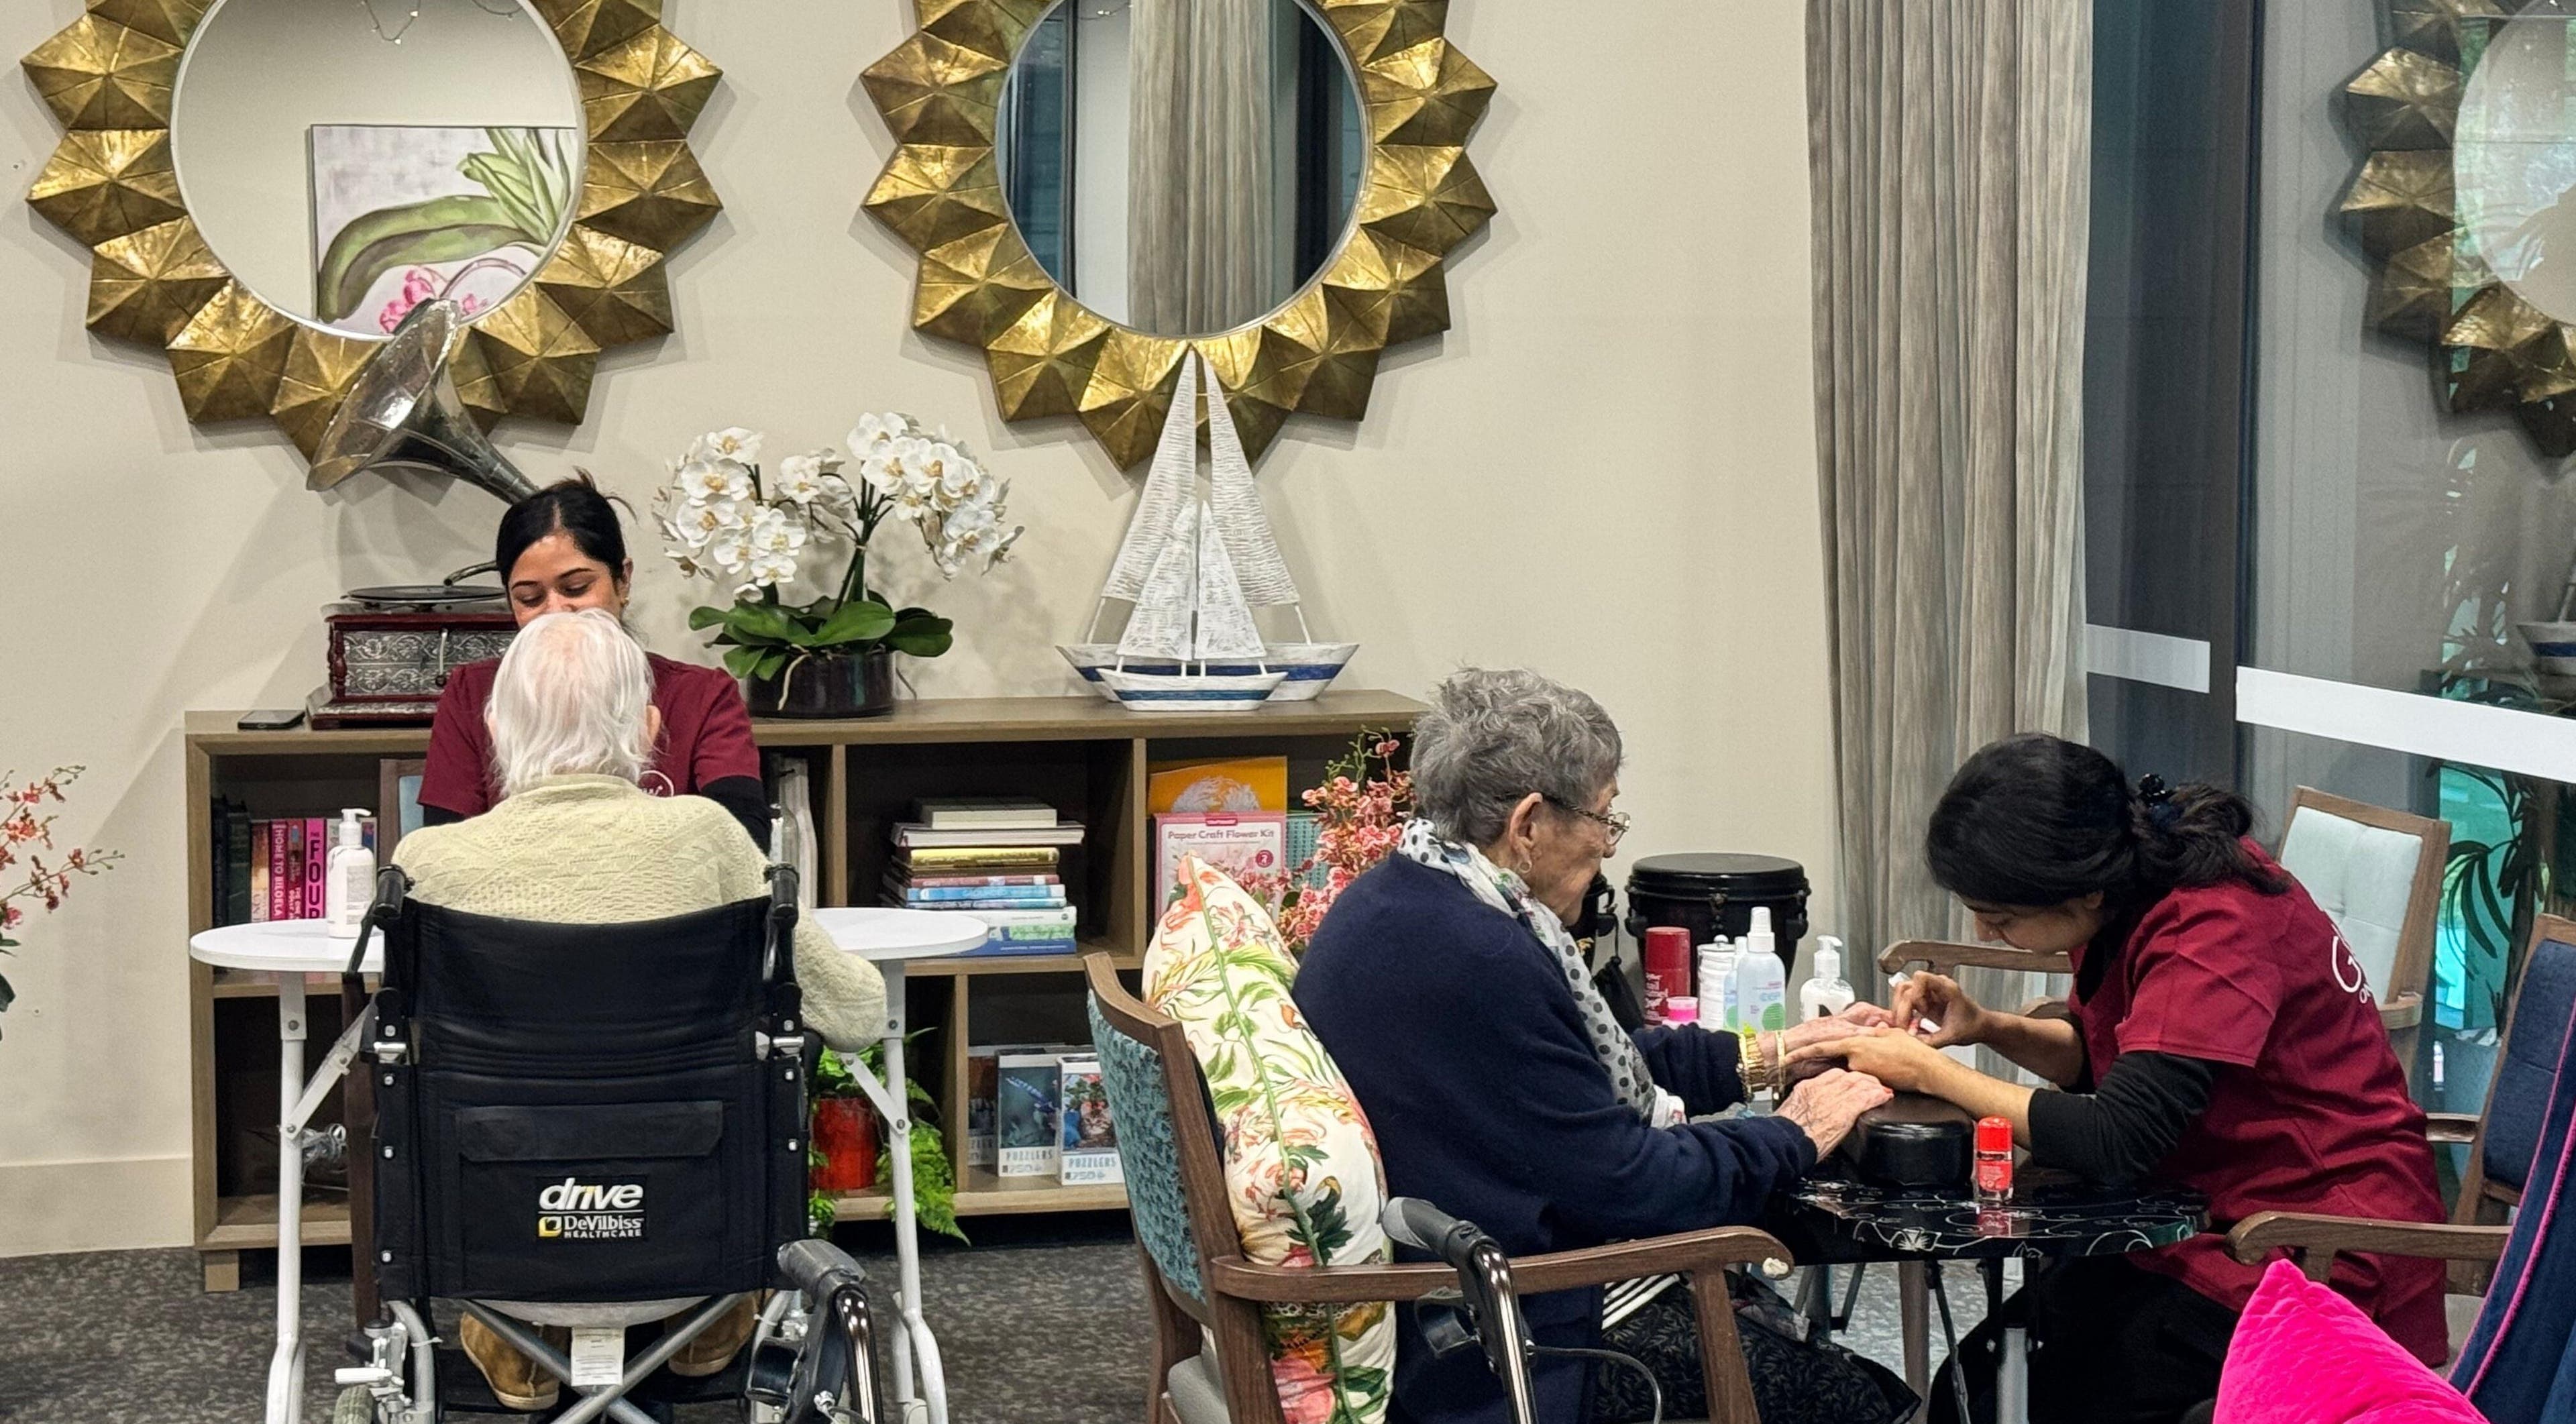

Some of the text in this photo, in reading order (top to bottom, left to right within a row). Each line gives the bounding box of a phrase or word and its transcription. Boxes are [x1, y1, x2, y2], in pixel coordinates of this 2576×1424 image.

[1168, 828, 1274, 841] Paper Craft Flower Kit
[274, 829, 284, 916] HOME TO BILOELA
[1006, 1149, 1053, 1161] PUZZLERS
[1069, 1156, 1116, 1168] PUZZLERS
[539, 1177, 644, 1210] drive
[564, 1214, 642, 1231] DeVilbiss
[564, 1229, 642, 1239] HEALTHCARE
